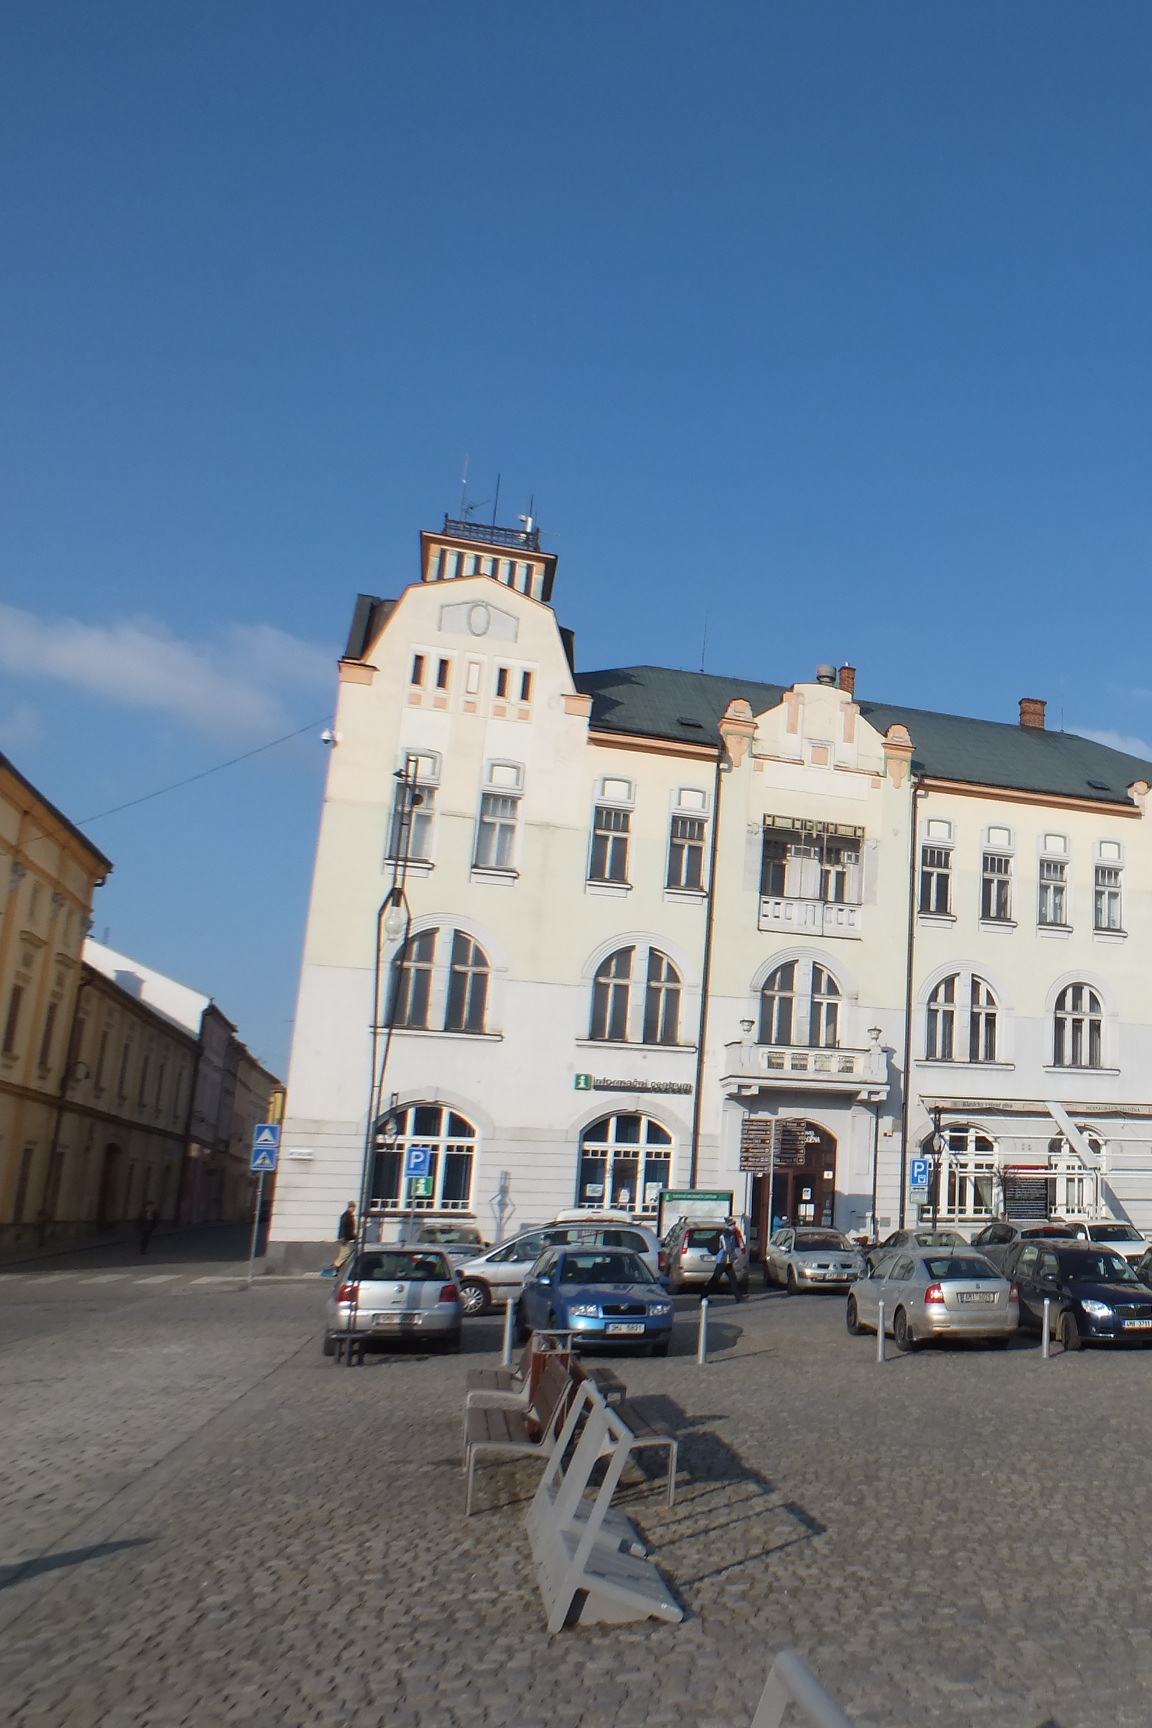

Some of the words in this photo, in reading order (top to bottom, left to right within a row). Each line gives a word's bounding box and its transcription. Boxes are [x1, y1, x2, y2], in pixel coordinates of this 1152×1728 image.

[650, 1079, 692, 1093] centrum
[409, 1151, 424, 1169] P
[914, 1161, 925, 1178] P
